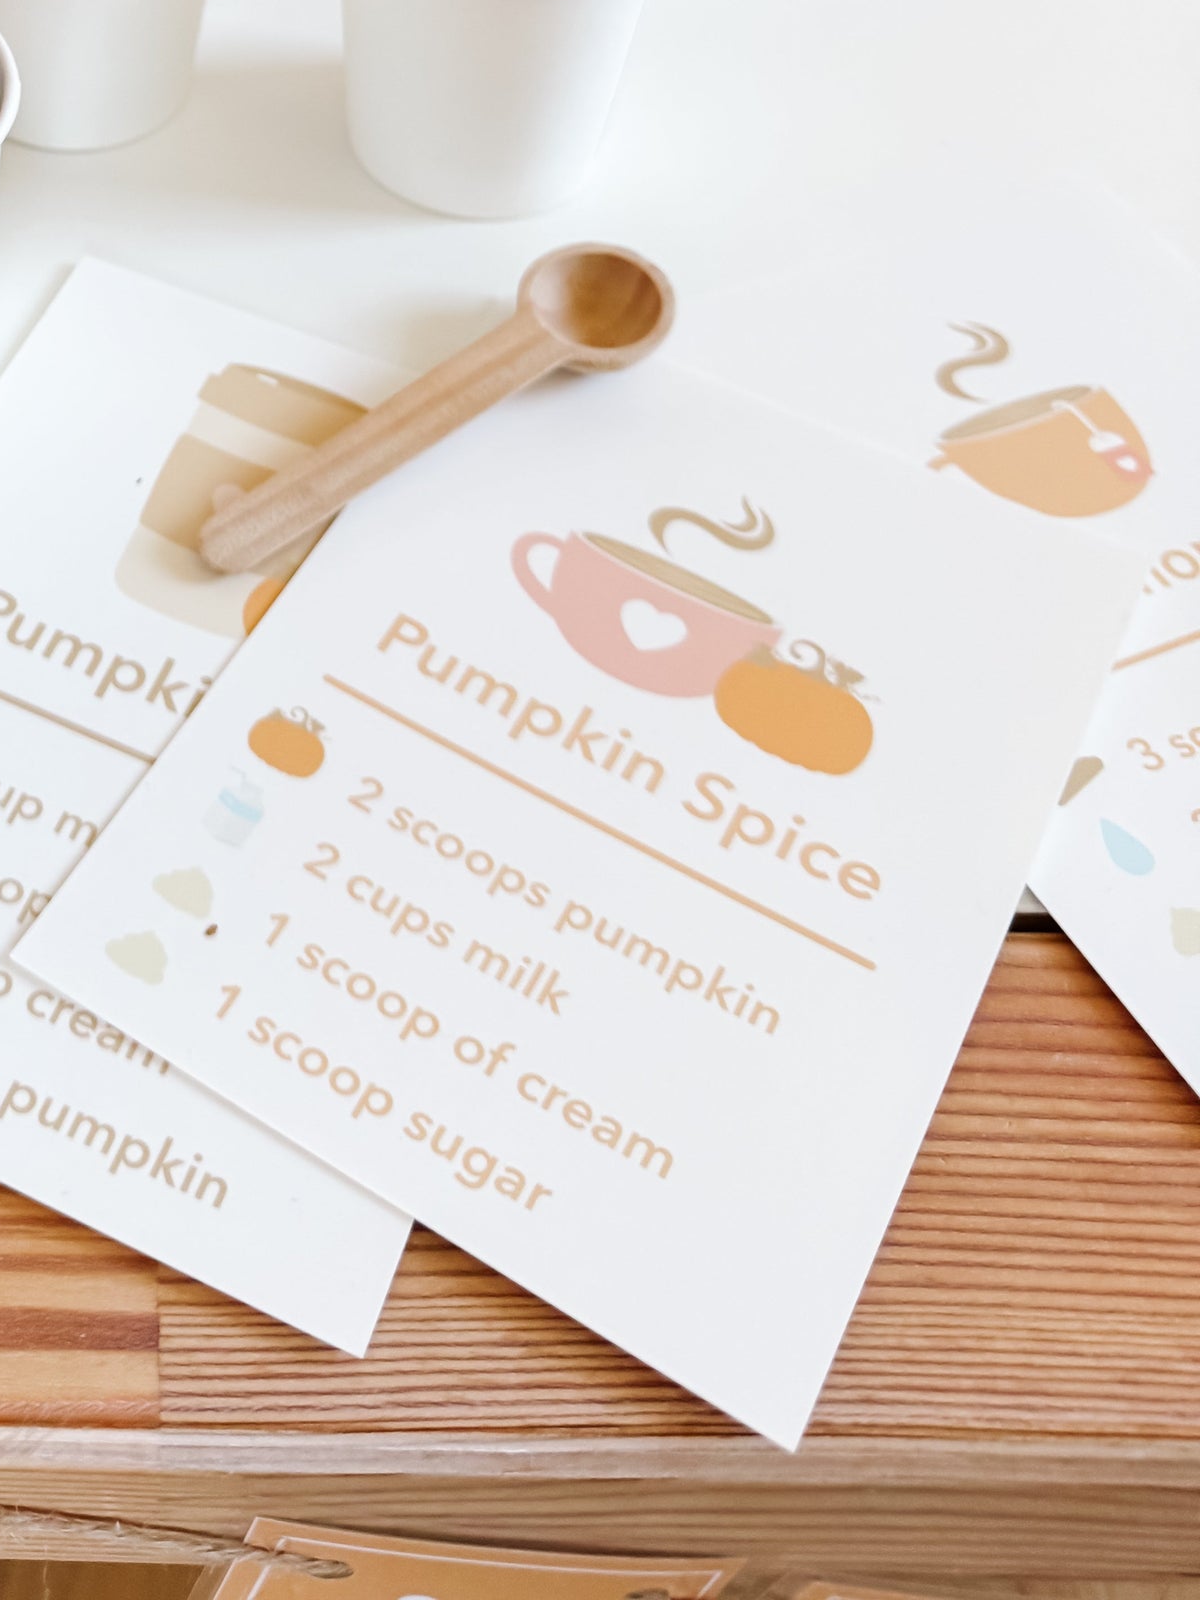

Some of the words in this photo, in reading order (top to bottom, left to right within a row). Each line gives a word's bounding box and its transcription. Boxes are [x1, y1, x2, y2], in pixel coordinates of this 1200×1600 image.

[376, 612, 667, 794] Pumpkin
[681, 771, 881, 900] Spice
[1126, 737, 1165, 771] 3
[304, 842, 340, 881] 2
[347, 872, 454, 950] cups
[462, 929, 570, 1015] milk
[347, 776, 384, 814] 2
[387, 803, 550, 909] scoops
[555, 900, 781, 1036] pumpkin
[215, 983, 242, 1020] 1
[248, 1014, 394, 1119] scoop
[402, 1108, 553, 1211] sugar
[267, 912, 290, 947] 1
[296, 941, 440, 1041] scoop
[453, 1034, 516, 1079] of
[516, 1067, 675, 1179] cream
